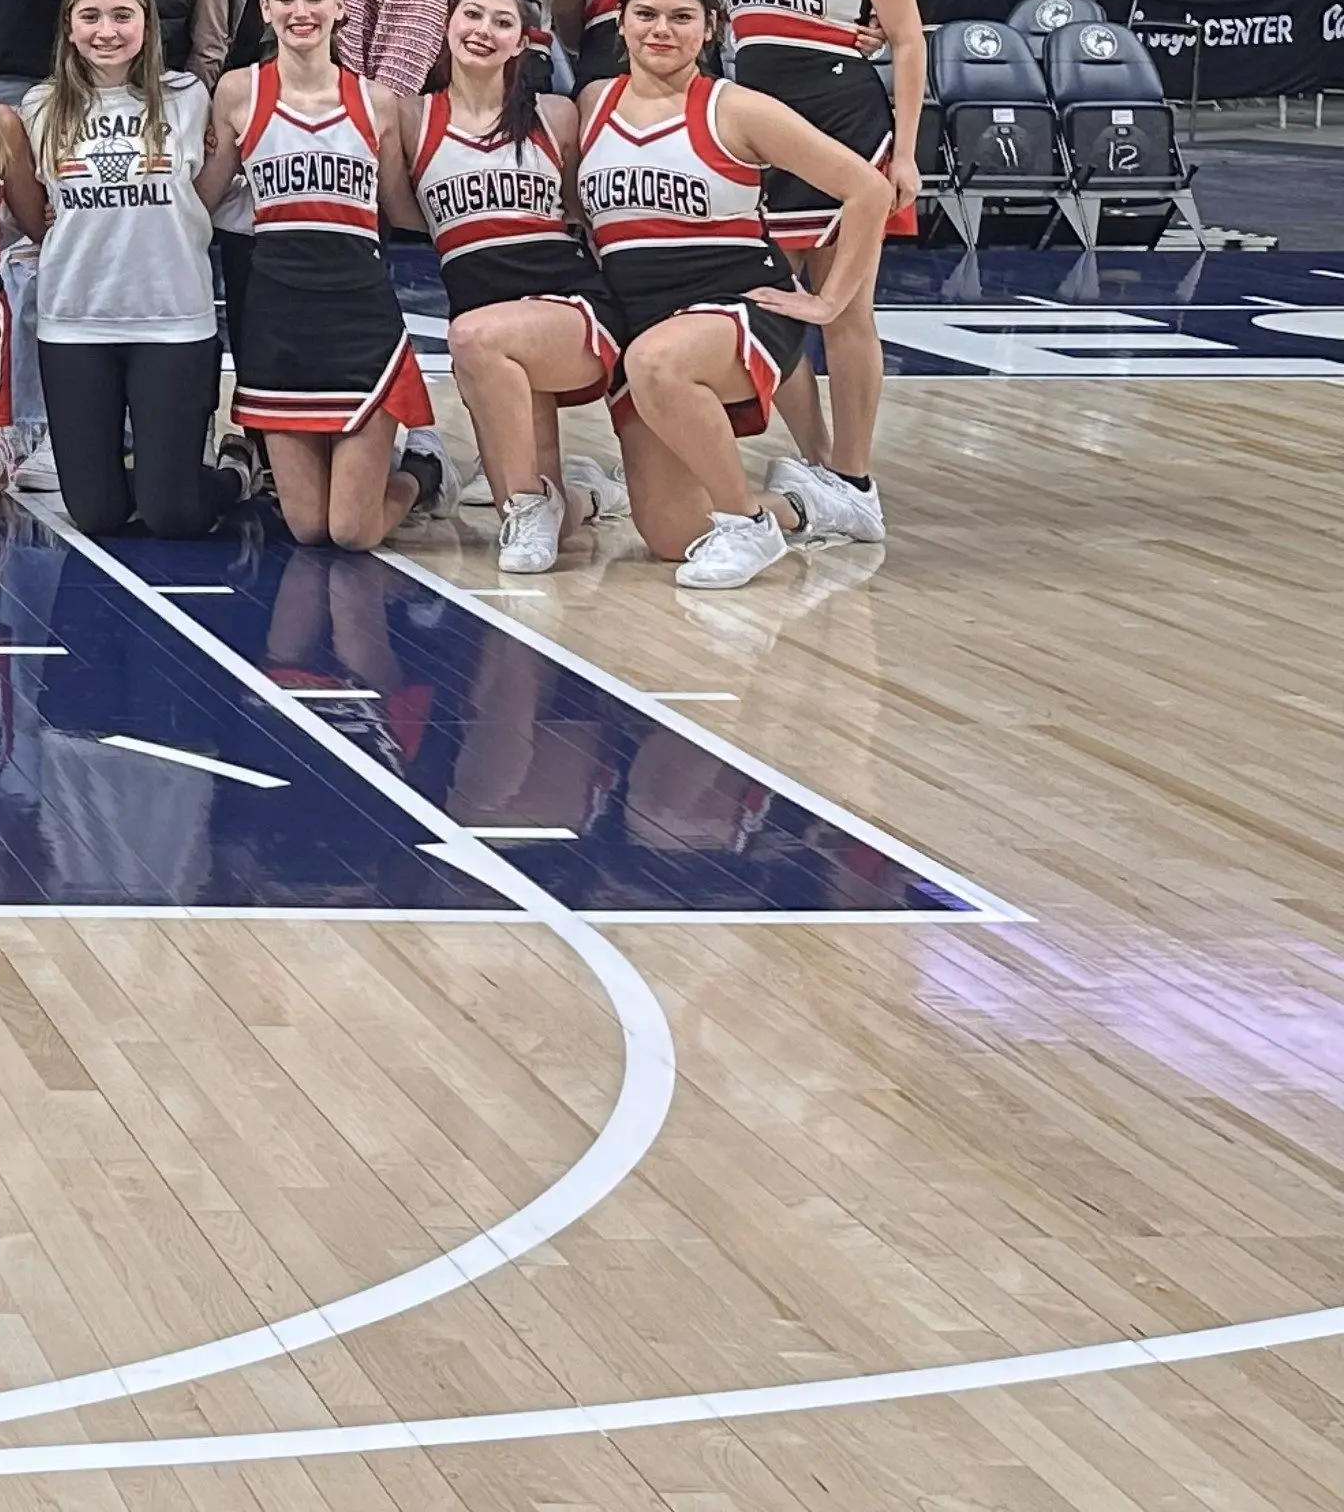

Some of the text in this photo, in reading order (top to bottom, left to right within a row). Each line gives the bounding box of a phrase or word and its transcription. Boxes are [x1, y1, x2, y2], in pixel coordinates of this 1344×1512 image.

[1204, 14, 1293, 47] CENTER
[1109, 141, 1140, 171] 12
[251, 155, 374, 200] CRUSADERS
[60, 182, 172, 210] BASKETBALL
[425, 174, 555, 223] CRUSADERS
